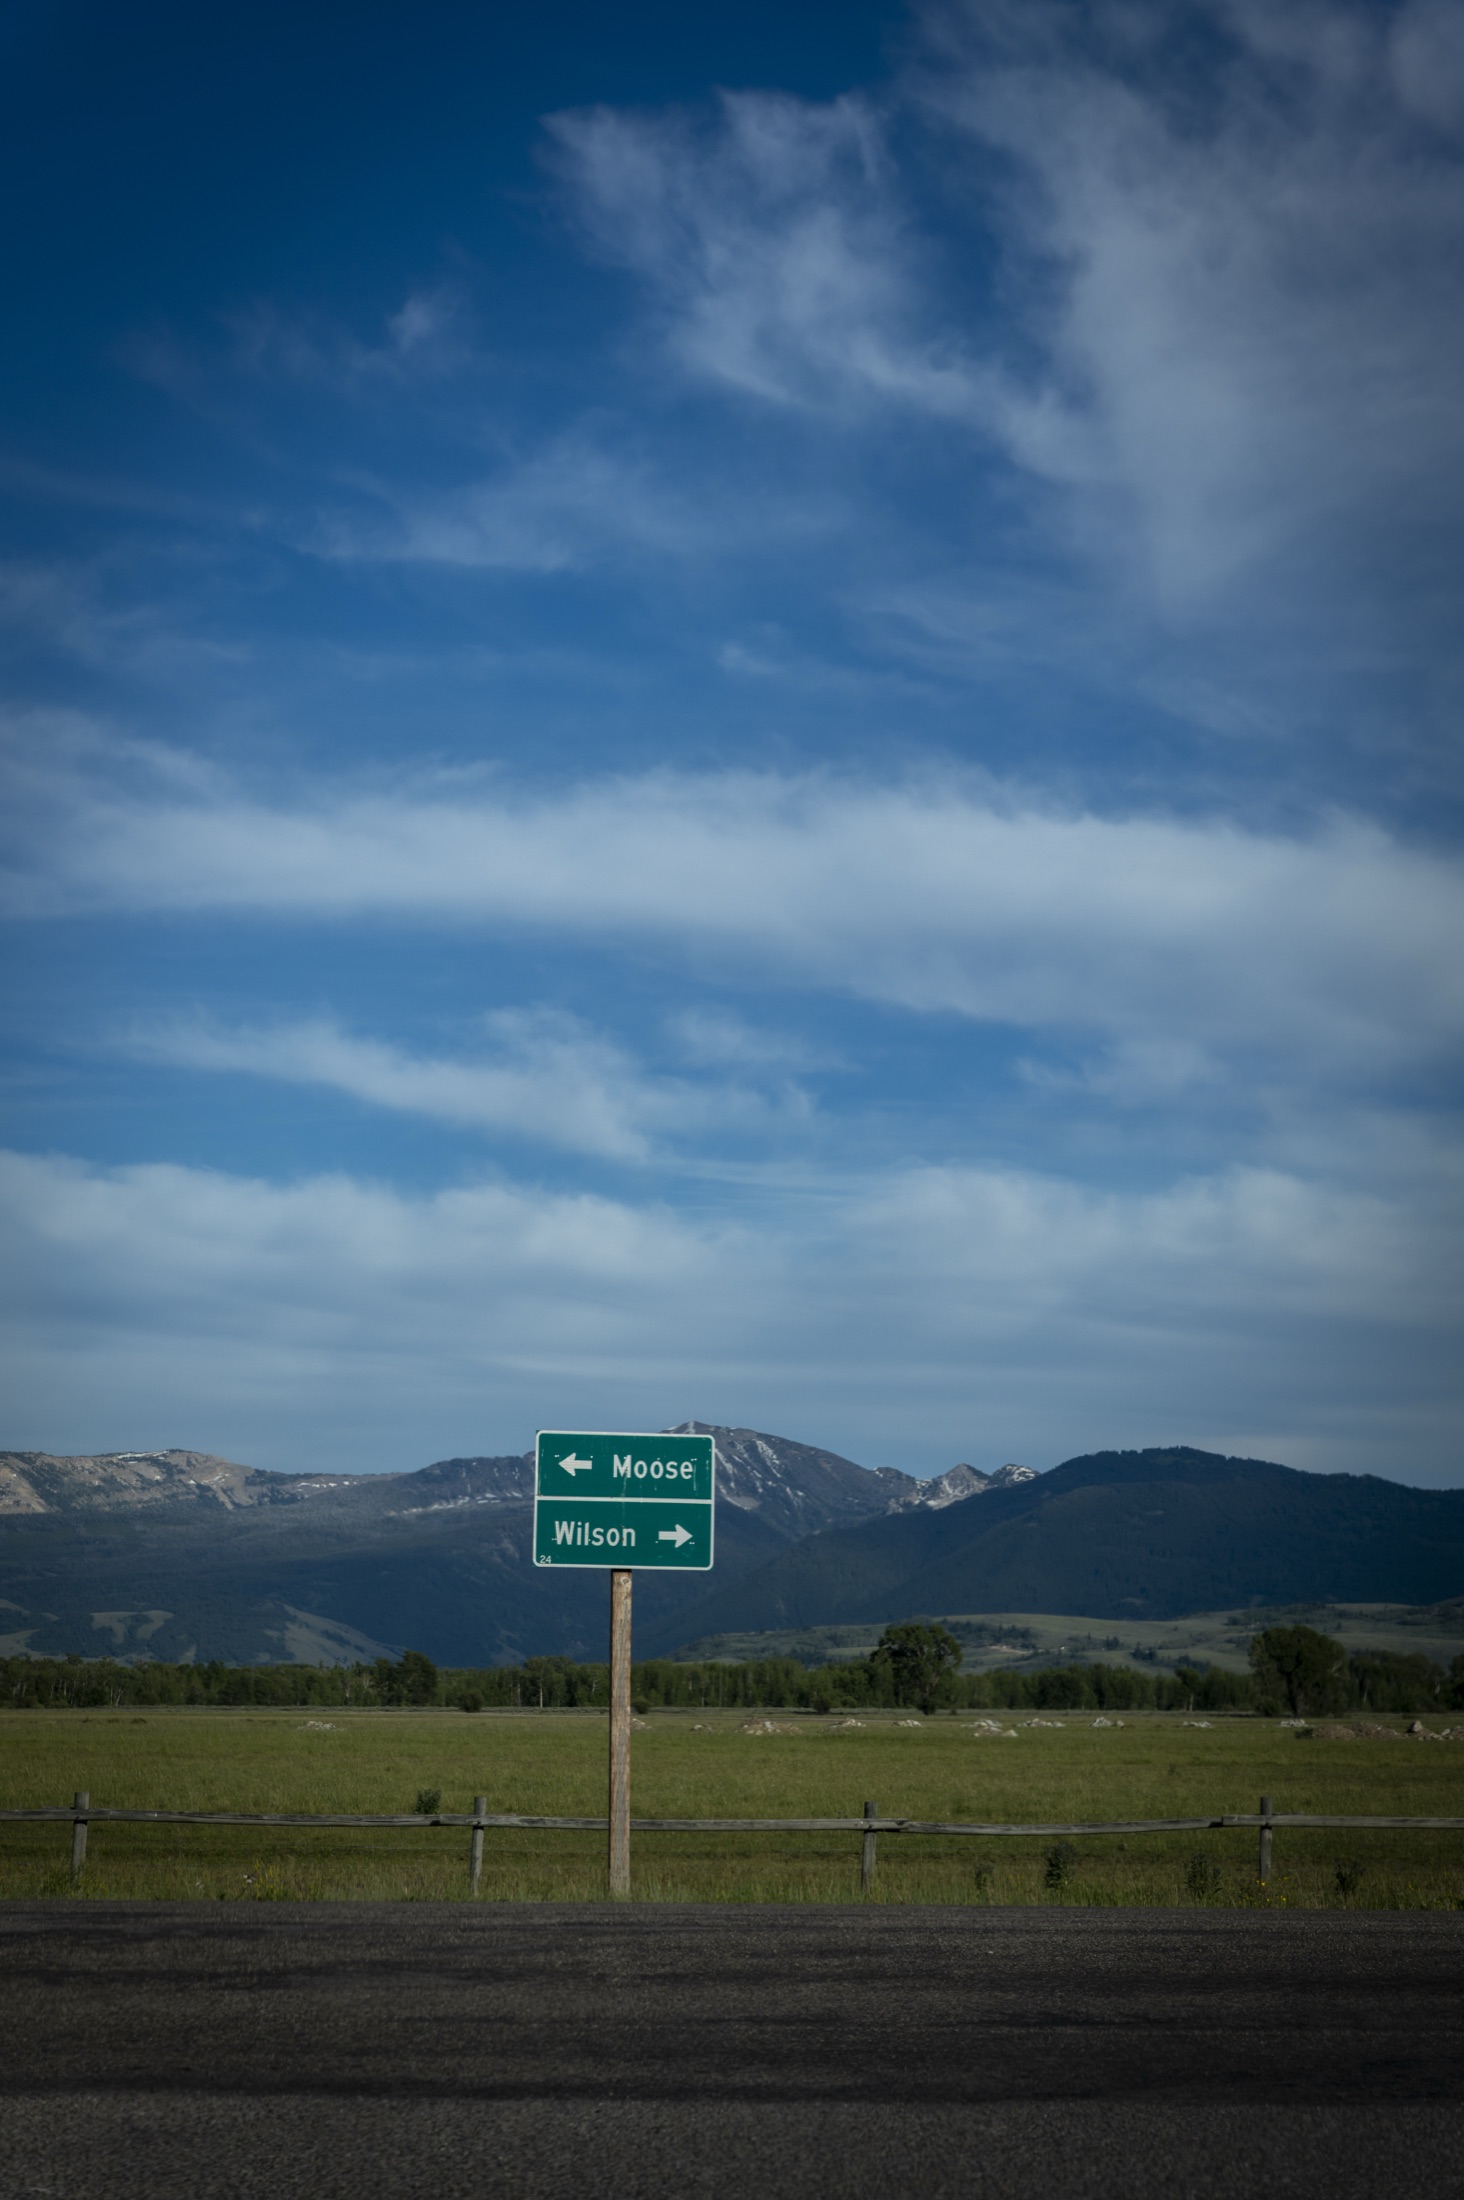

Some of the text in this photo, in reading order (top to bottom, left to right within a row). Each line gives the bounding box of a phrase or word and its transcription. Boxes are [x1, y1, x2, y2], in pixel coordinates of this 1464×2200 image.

[612, 1454, 694, 1480] Moose
[554, 1520, 636, 1547] Wilson
[539, 1554, 552, 1564] 24
